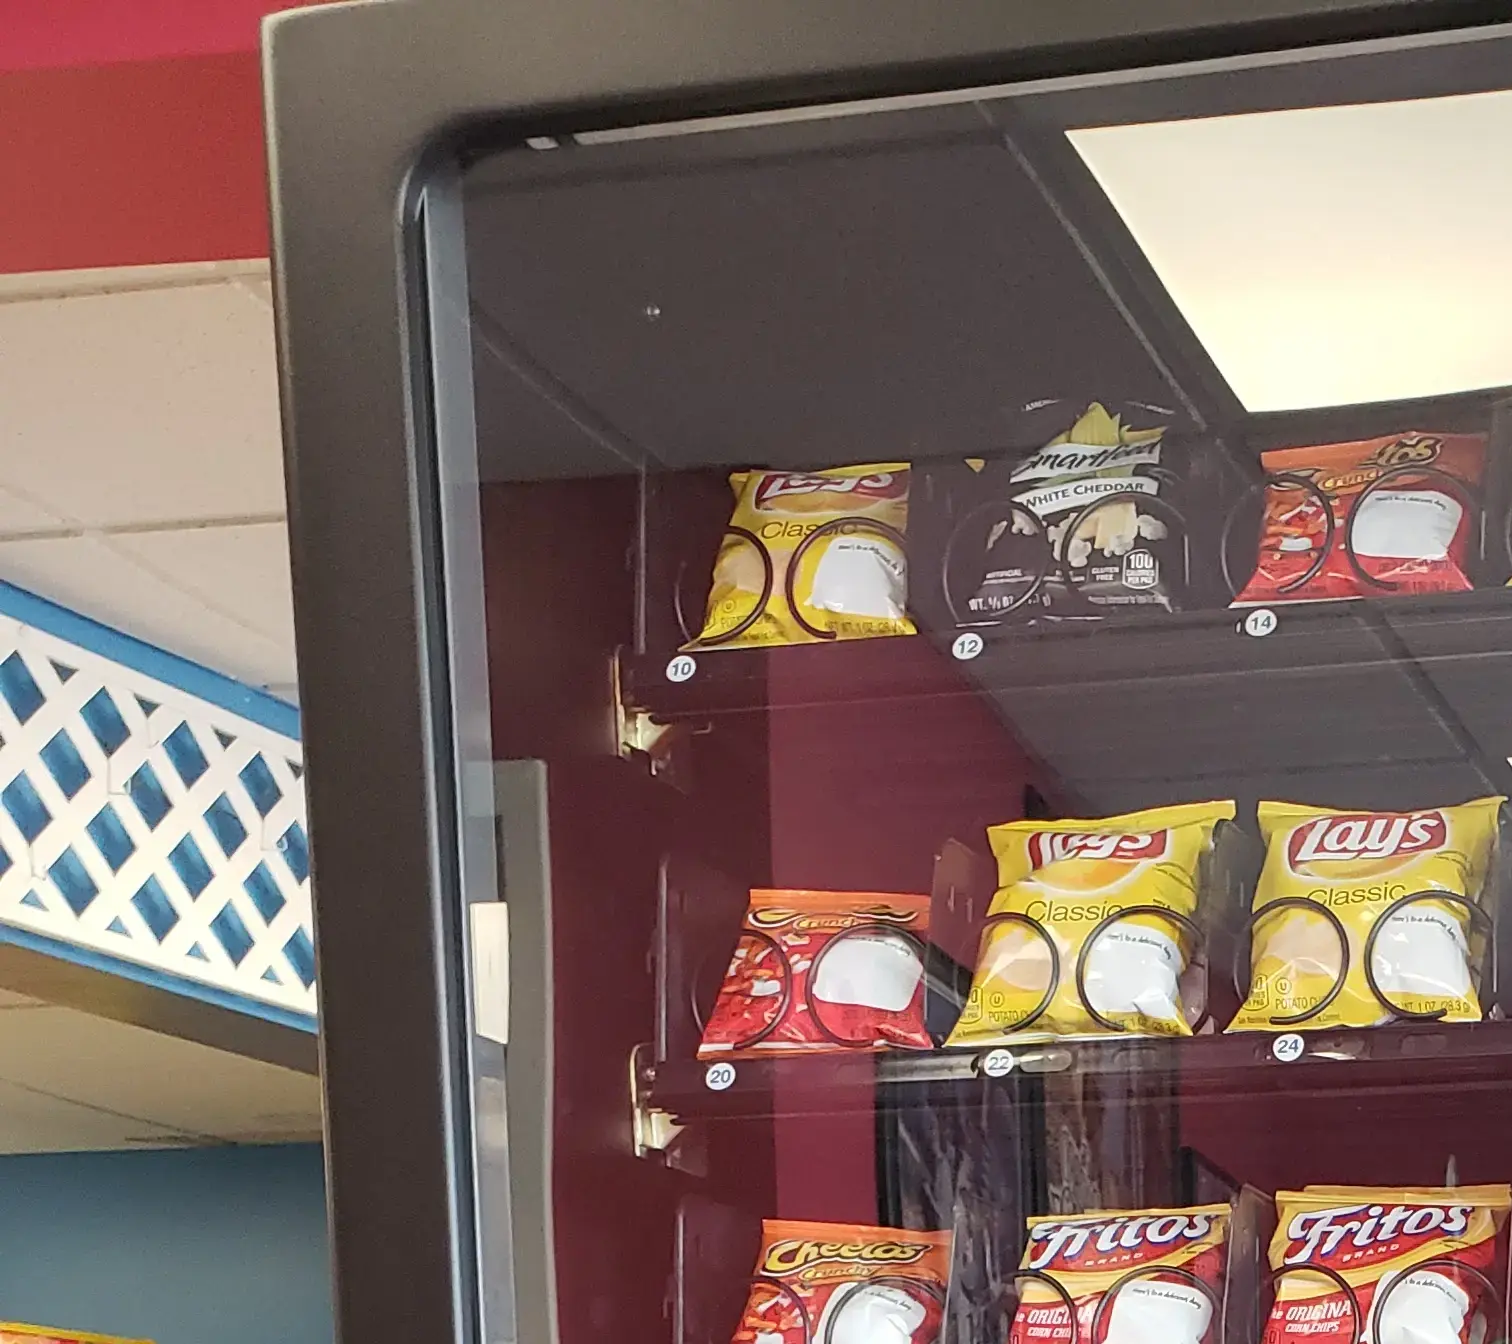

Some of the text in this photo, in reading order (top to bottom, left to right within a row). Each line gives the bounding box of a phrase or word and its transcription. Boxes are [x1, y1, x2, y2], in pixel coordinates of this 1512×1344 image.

[1025, 483, 1146, 509] WHITE CHEDDAR
[1129, 553, 1154, 569] 100
[1251, 615, 1272, 631] 14
[957, 639, 979, 654] 12
[671, 661, 693, 677] 10
[1294, 813, 1441, 862] Lay's
[1306, 881, 1408, 907] Classic
[1275, 996, 1309, 1011] POTATO
[1276, 1039, 1300, 1055] 24
[987, 1055, 1011, 1072] 22
[709, 1069, 733, 1085] 20
[1283, 1203, 1475, 1265] Fritos
[1029, 1215, 1215, 1270] Fritos
[1084, 1252, 1146, 1267] BRAND
[1342, 1243, 1401, 1262] BRAND
[799, 1265, 879, 1279] Crunchy
[1026, 1326, 1050, 1339] CORN
[1285, 1320, 1341, 1334] CORN CHIPS
